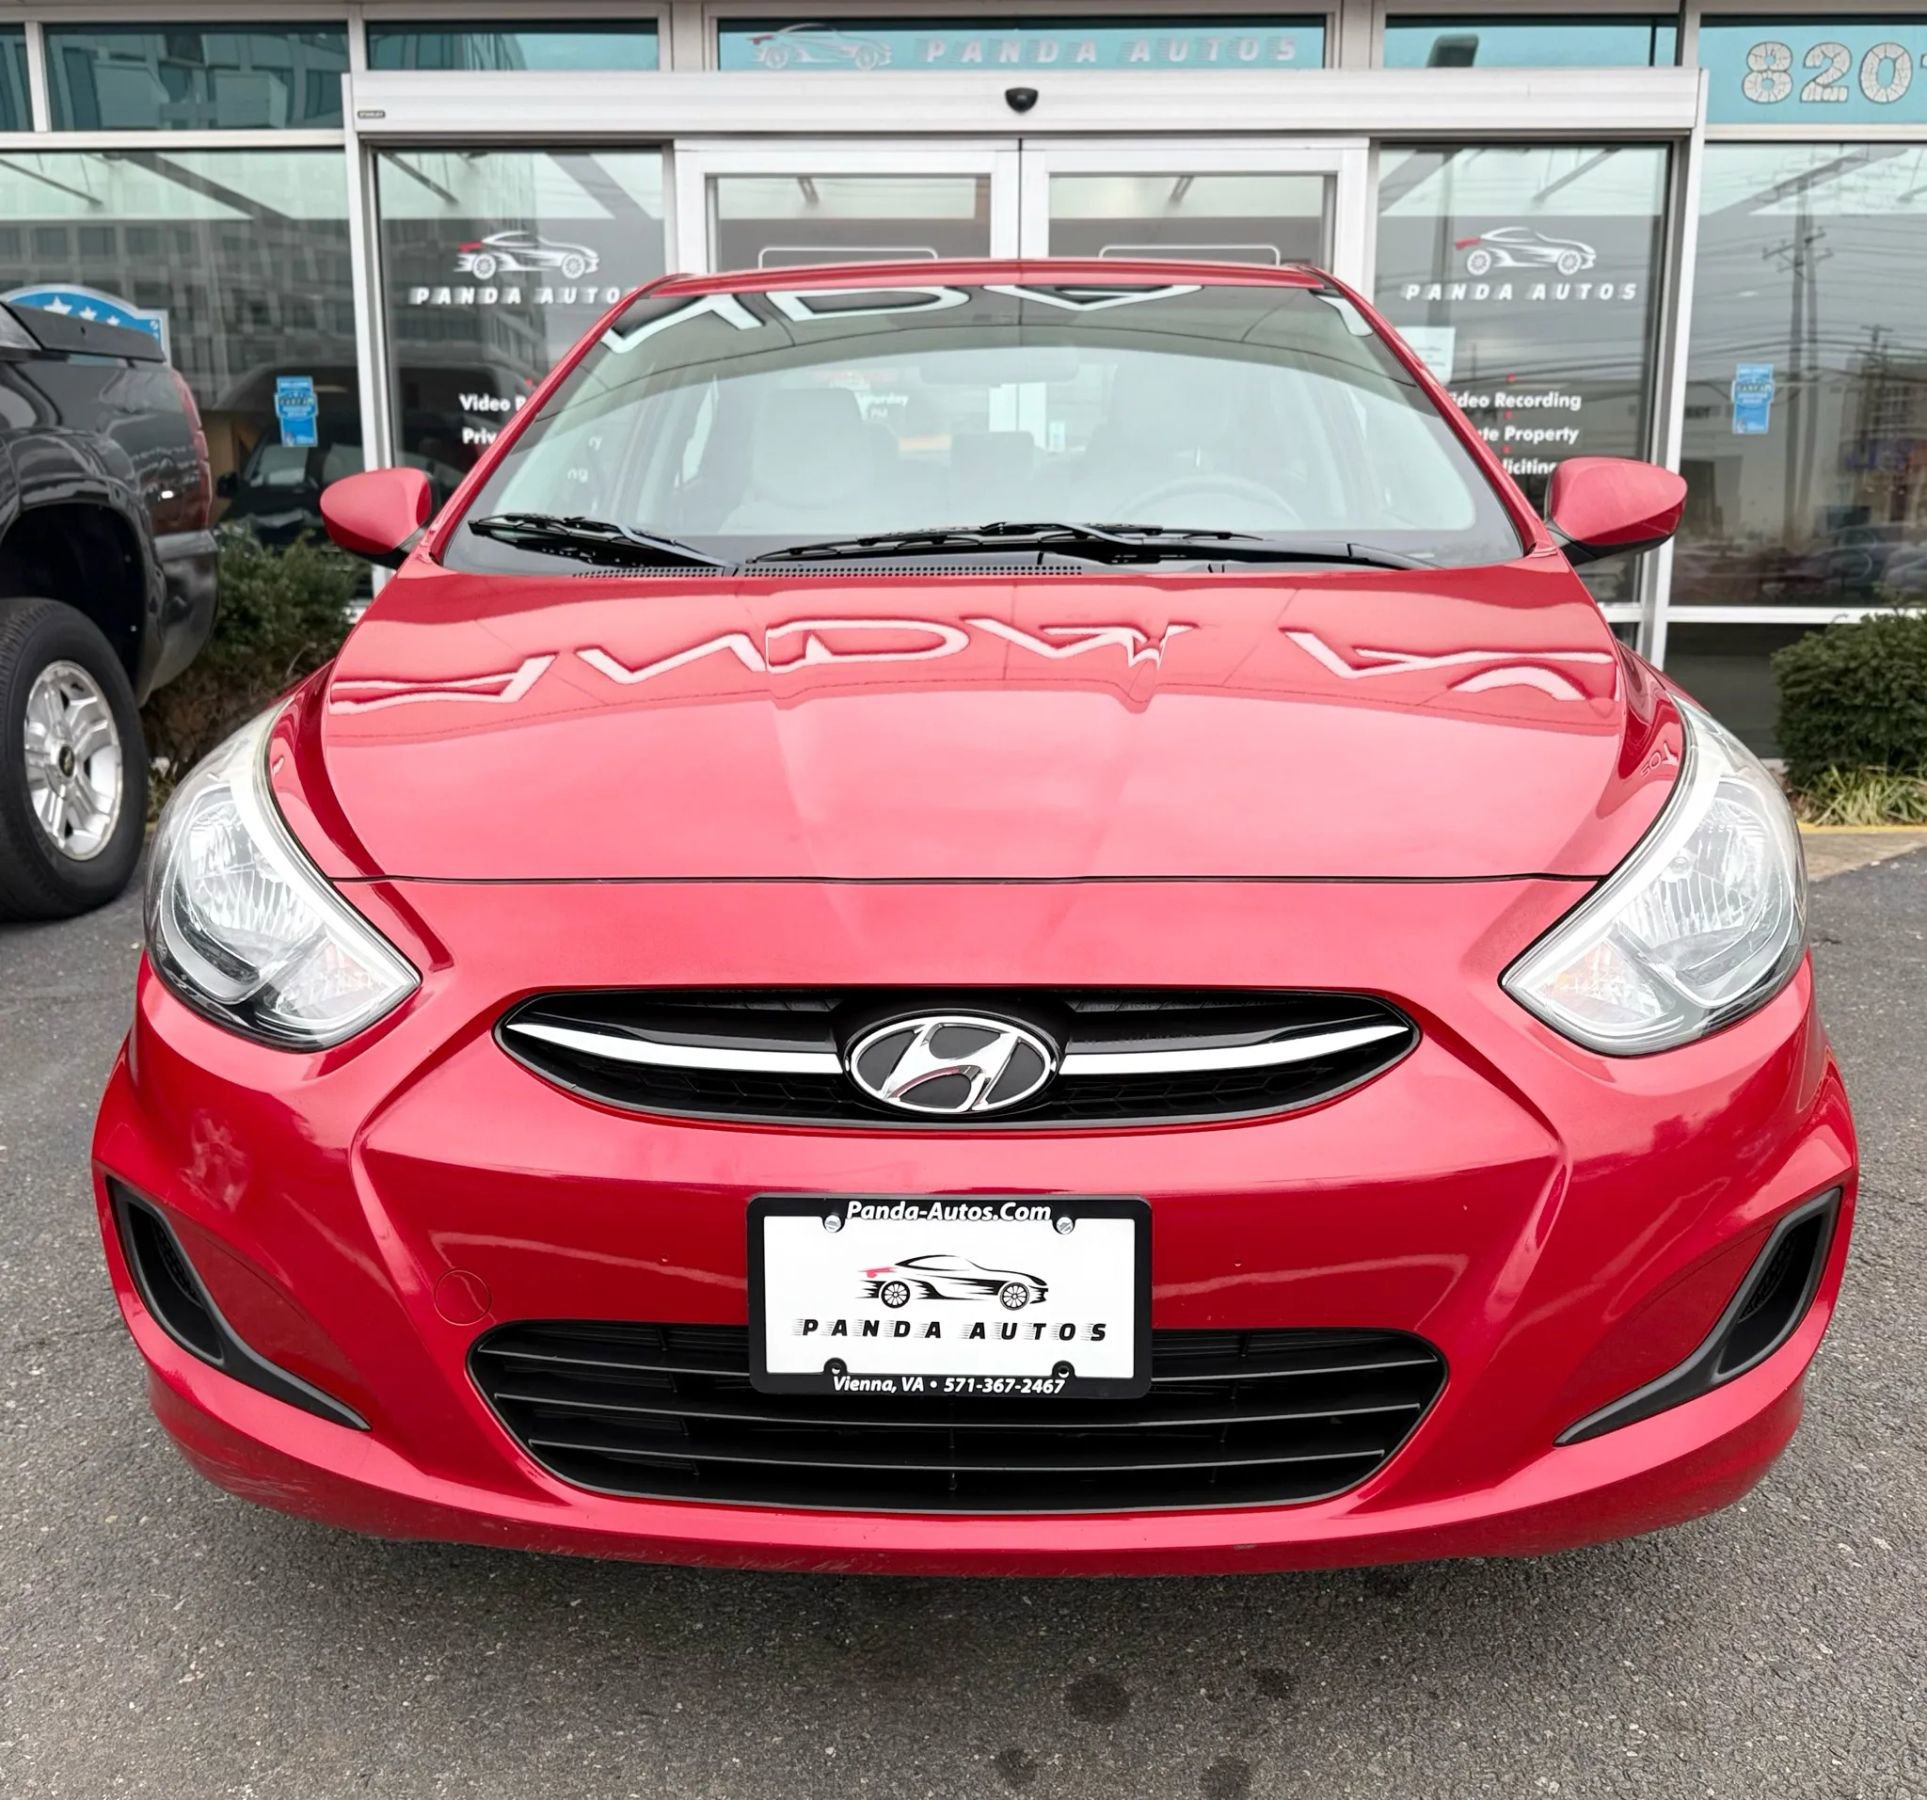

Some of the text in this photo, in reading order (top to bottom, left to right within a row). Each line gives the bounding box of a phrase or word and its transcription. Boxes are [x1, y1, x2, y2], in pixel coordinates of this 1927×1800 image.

[924, 37, 1297, 63] PANDA AUTOS
[1741, 41, 1927, 104] 820
[414, 287, 622, 304] PANDA AUTO
[1405, 283, 1637, 300] PANDA AUTOS
[459, 393, 511, 412] Video
[1450, 391, 1582, 411] ideo Recording
[461, 427, 497, 444] Priv
[1504, 425, 1579, 444] Property
[1501, 457, 1557, 475] licitin
[846, 1200, 1052, 1222] Panda-Autos.Com
[800, 1318, 1107, 1342] PANDA AUTOS
[832, 1375, 1066, 1395] Vienna, VA 571-367-2467
